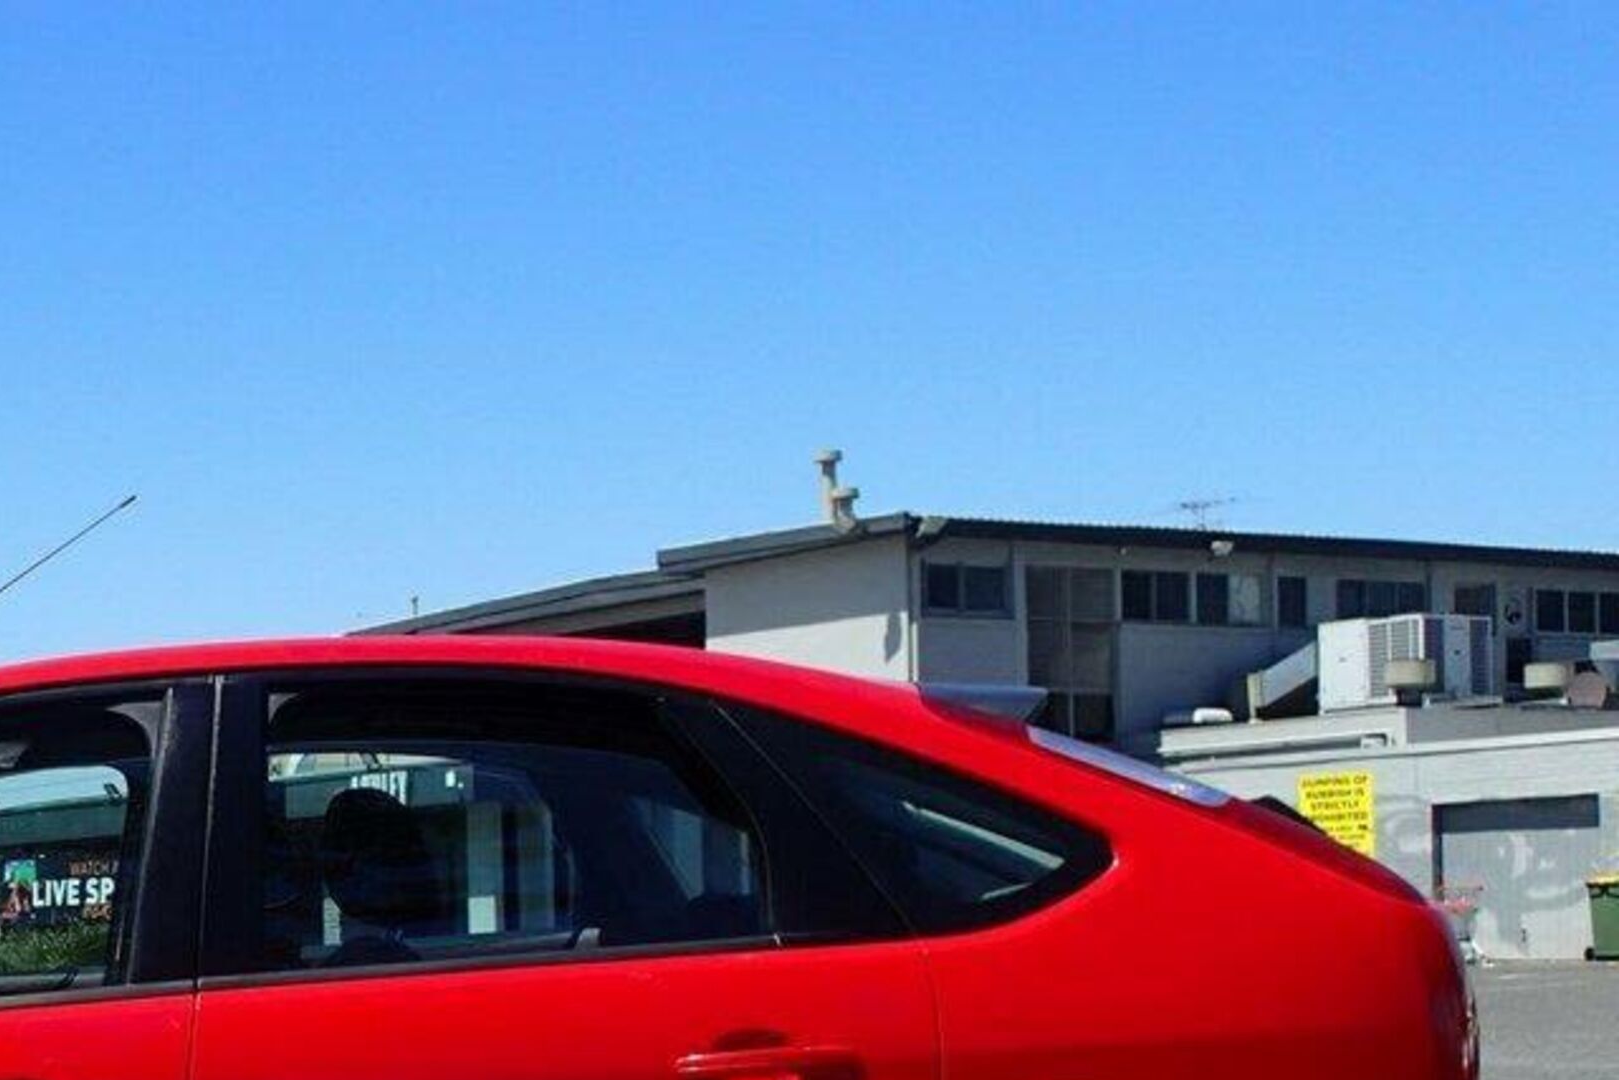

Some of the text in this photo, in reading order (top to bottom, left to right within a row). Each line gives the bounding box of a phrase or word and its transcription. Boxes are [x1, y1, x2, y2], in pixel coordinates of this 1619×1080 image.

[1301, 775, 1367, 788] DUMPING OF
[1305, 787, 1365, 800] RUBBISH IS
[1310, 800, 1360, 811] STRICTLY
[68, 859, 112, 876] WATCH
[32, 878, 81, 907] LIVE
